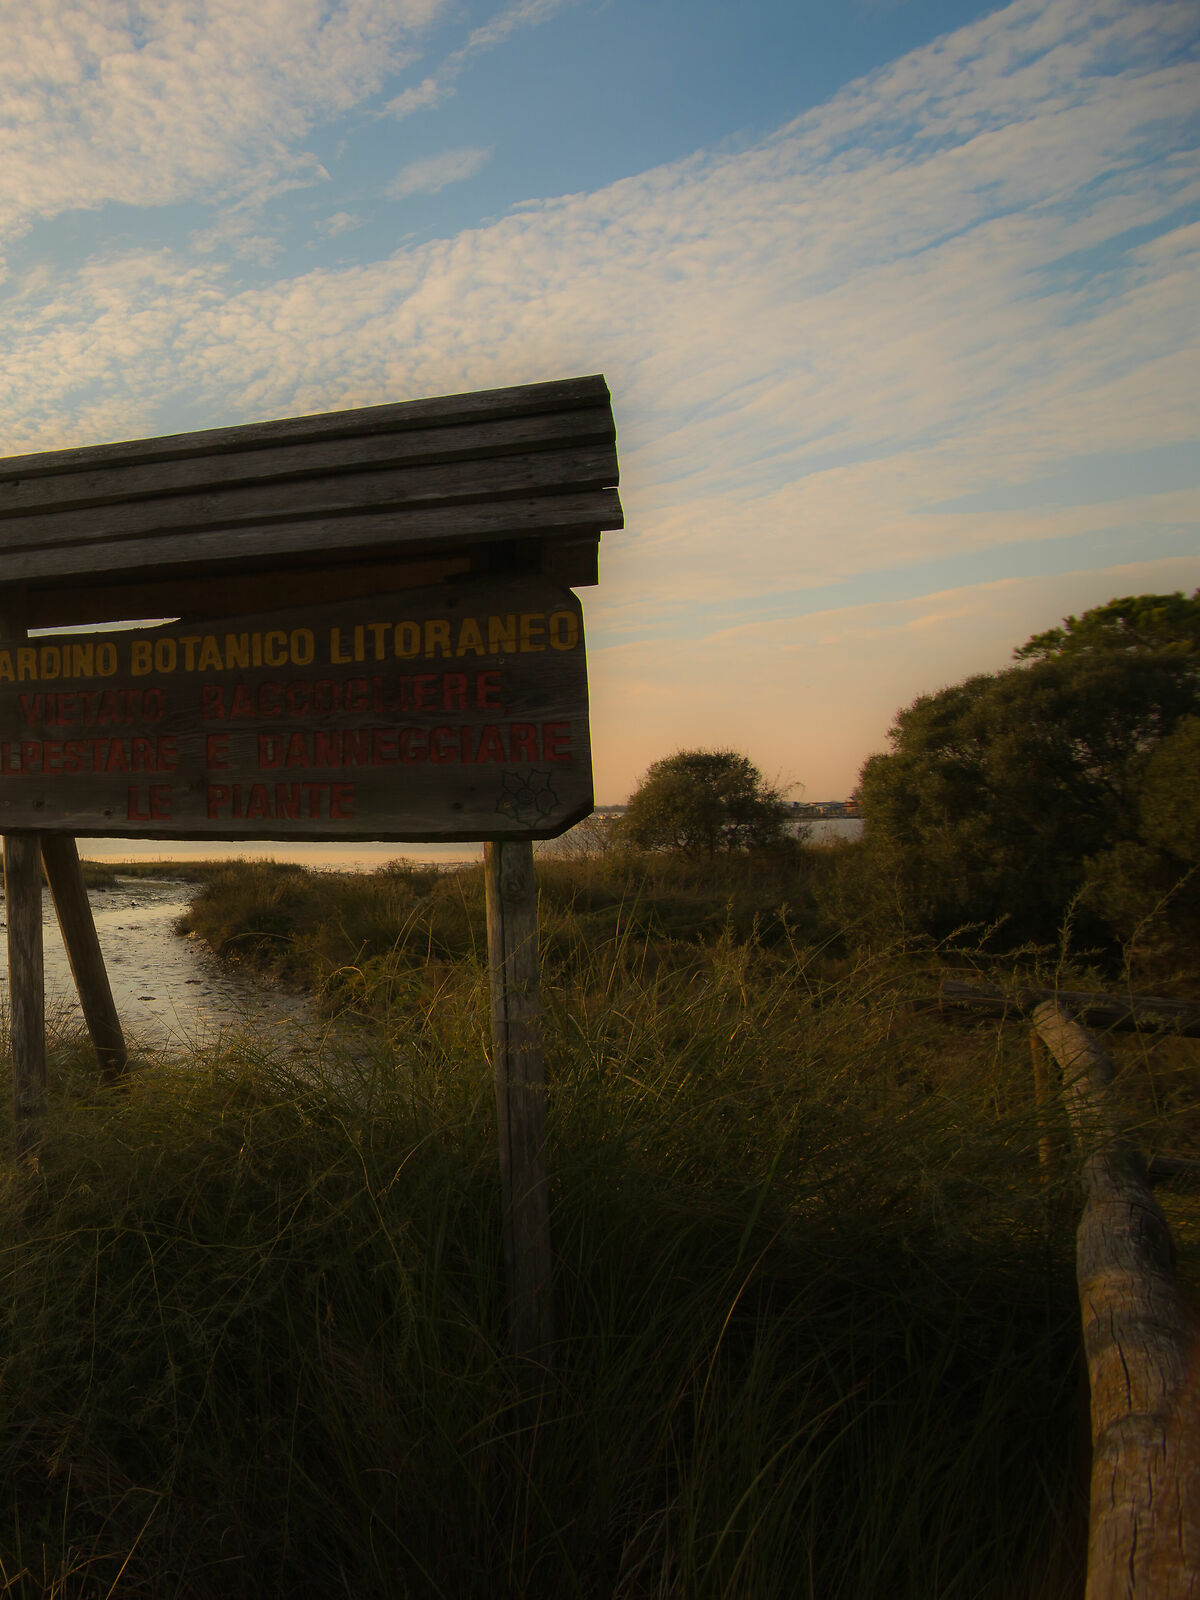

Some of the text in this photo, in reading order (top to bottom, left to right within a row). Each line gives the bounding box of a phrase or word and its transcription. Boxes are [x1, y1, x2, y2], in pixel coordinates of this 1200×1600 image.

[131, 628, 315, 676] BOTANICO
[330, 610, 579, 664] LITORANEO
[19, 687, 165, 727] VIETATO
[206, 733, 229, 770] E
[258, 722, 571, 770] DANNEGGIARE
[127, 782, 355, 821] LE PIANTE
